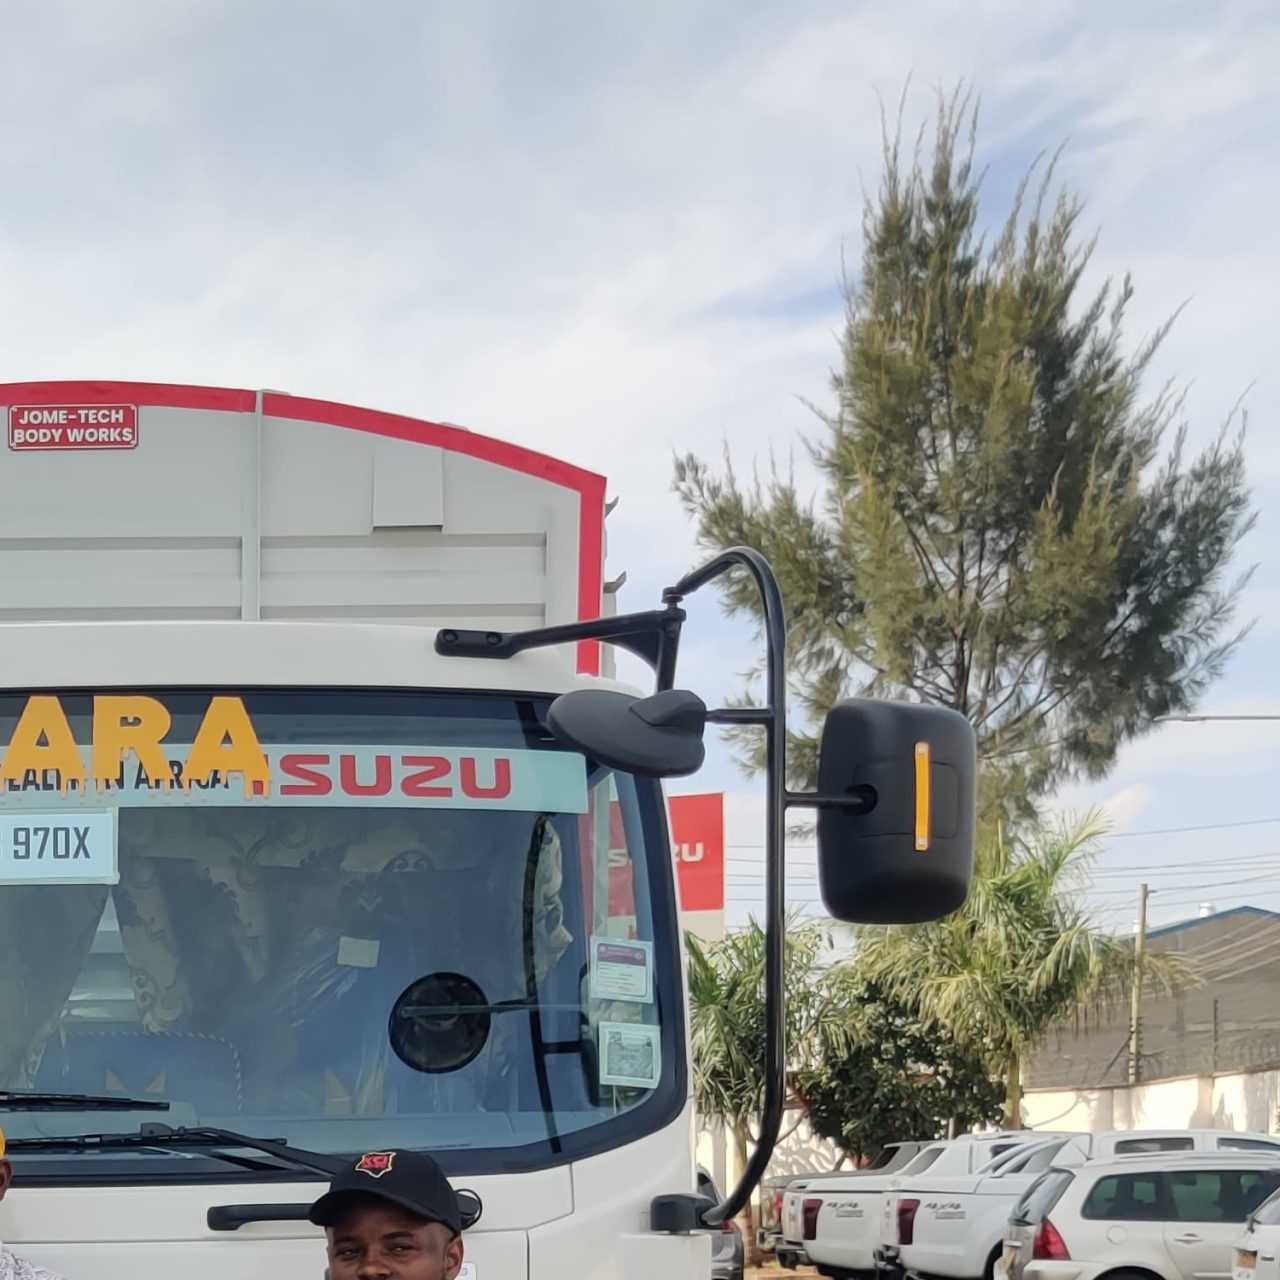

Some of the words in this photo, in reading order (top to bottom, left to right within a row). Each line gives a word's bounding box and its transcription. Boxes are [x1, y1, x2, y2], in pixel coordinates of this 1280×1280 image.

[18, 409, 123, 425] JOME-TECH
[14, 428, 63, 443] BODY
[67, 427, 133, 443] WORKS
[13, 826, 91, 860] 970X
